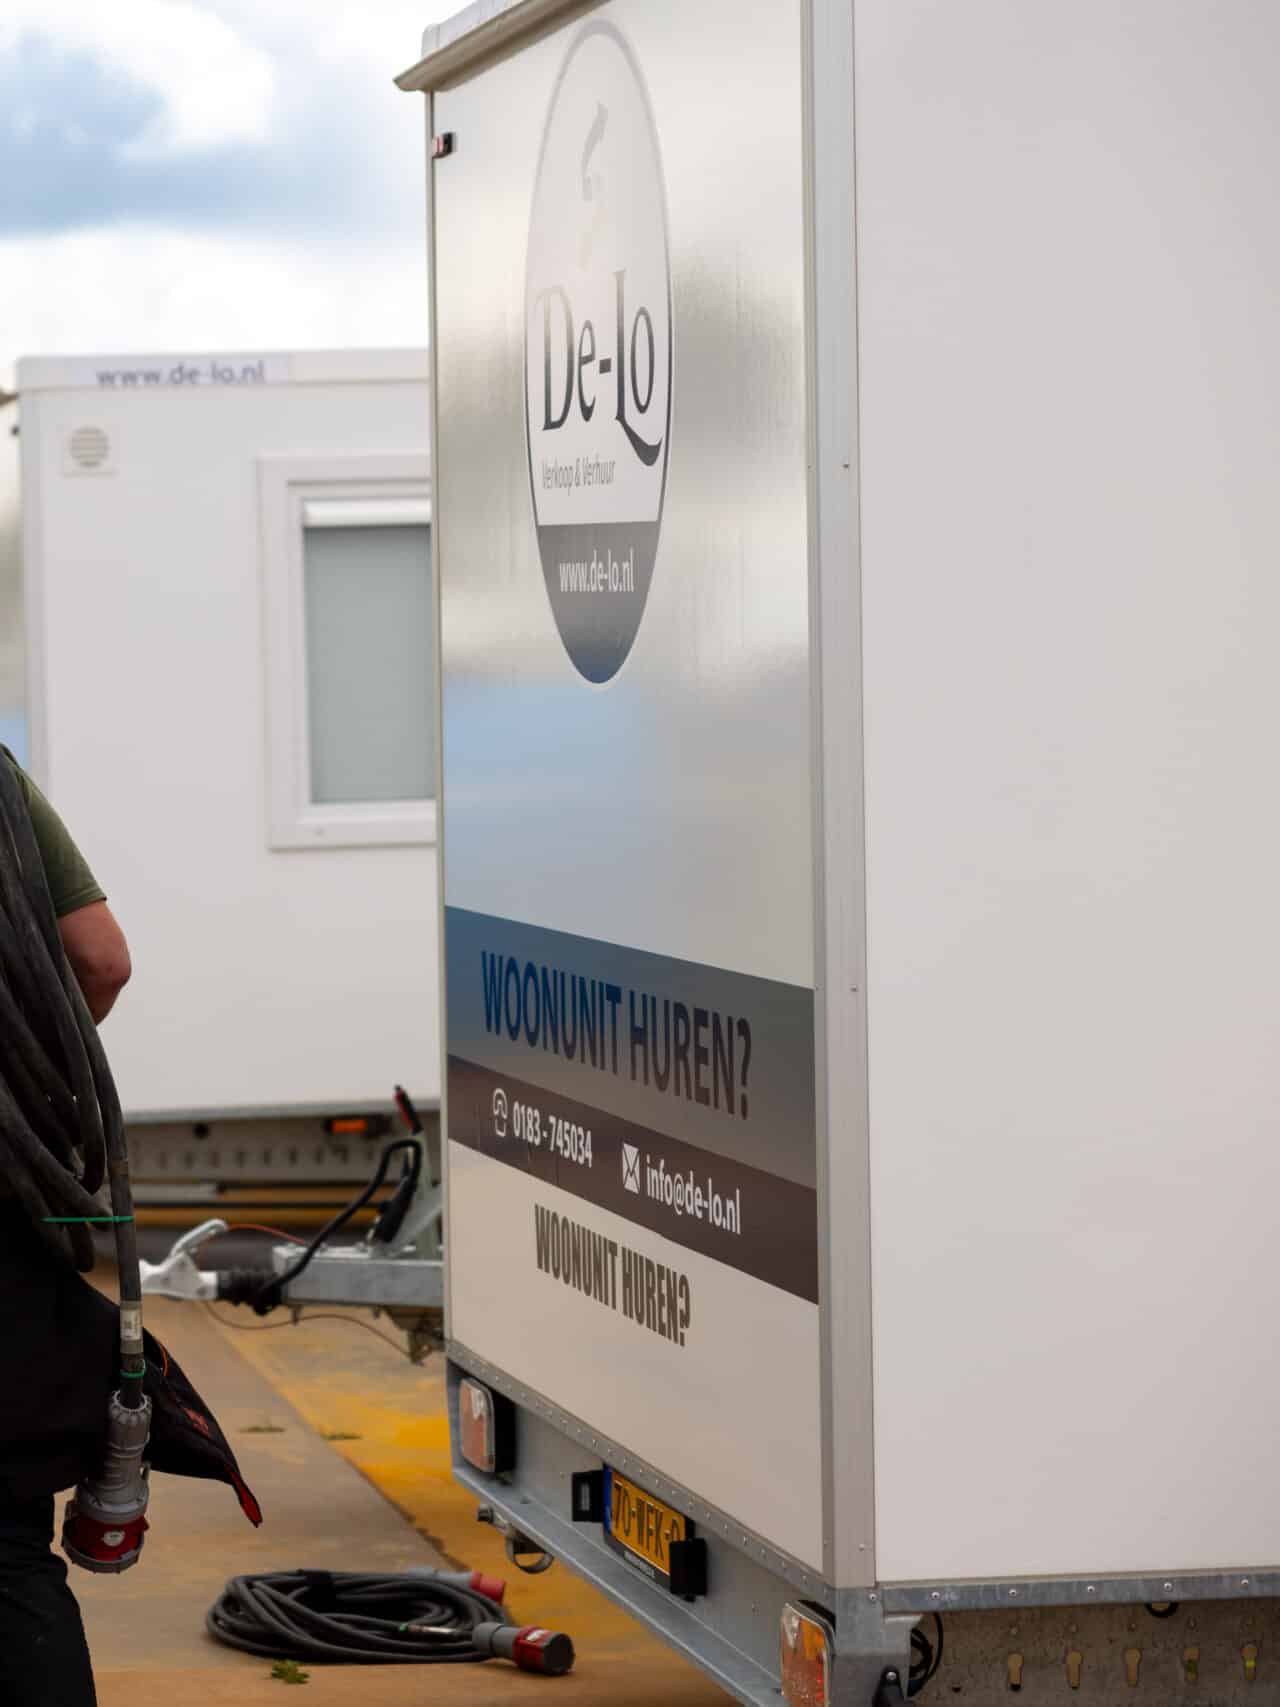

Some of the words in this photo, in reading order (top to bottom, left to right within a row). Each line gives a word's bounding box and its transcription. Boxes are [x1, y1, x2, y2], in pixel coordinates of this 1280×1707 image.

[95, 360, 266, 386] www.de-lo.nl
[542, 461, 573, 496] Verkoop
[574, 457, 581, 487] &
[583, 452, 616, 487] Verhuur
[559, 547, 635, 593] www.de-lo.nl
[481, 950, 622, 1075] WOONUNIT
[629, 989, 752, 1120] HUREN?
[513, 1101, 541, 1146] 0183
[548, 1115, 593, 1169] 745034
[646, 1154, 741, 1235] info@de-lo.nl
[534, 1202, 618, 1311] WOONUNIT
[621, 1245, 691, 1347] HUREN?
